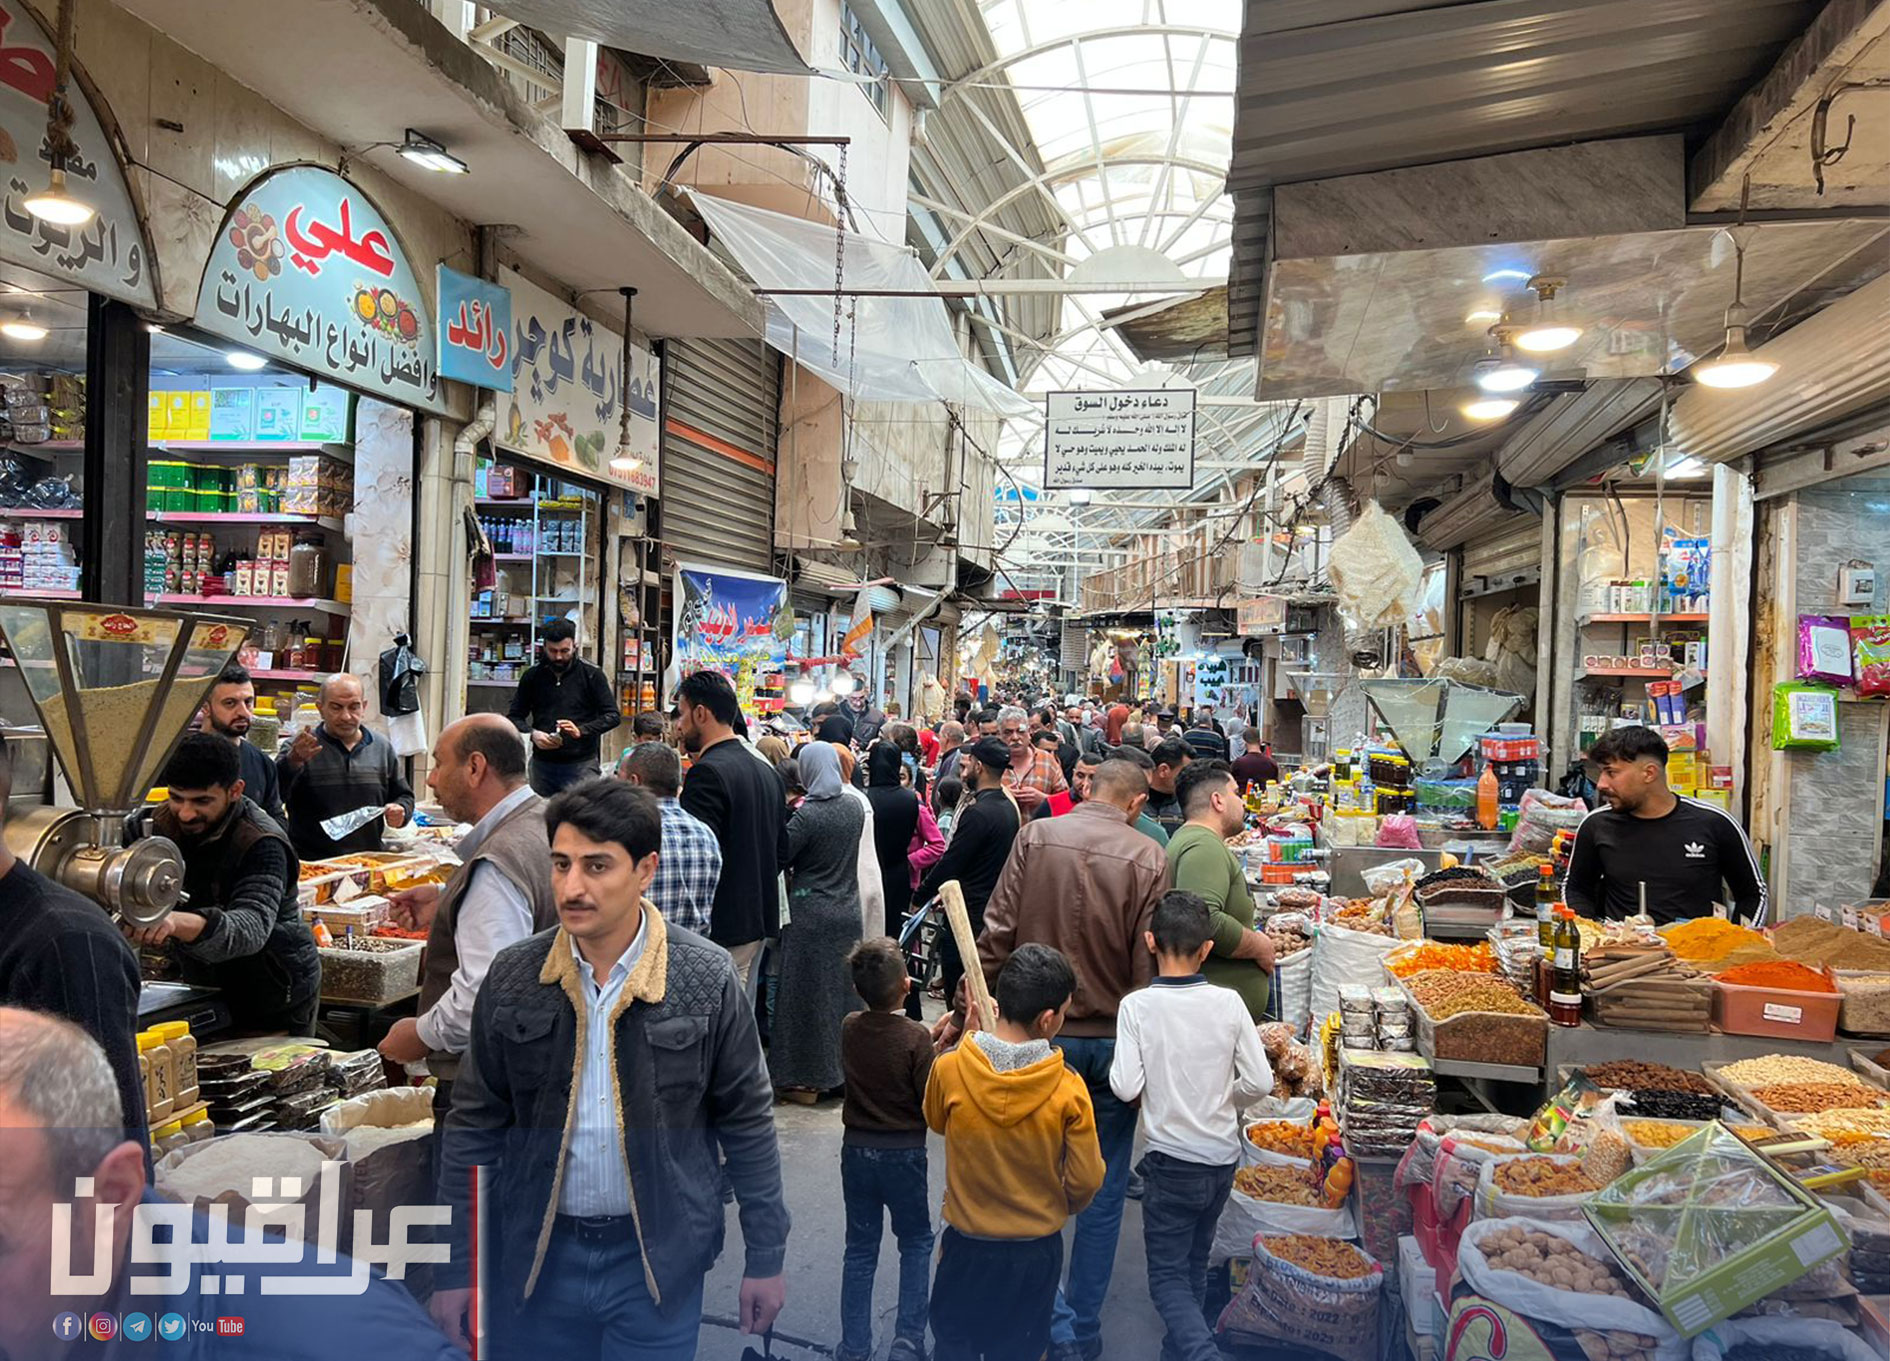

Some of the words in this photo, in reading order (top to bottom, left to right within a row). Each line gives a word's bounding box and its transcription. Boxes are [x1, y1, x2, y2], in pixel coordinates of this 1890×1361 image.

[285, 197, 395, 278] علي
[216, 270, 321, 354] البهارات
[448, 300, 508, 369] رائد
[325, 323, 377, 374] انواع
[380, 345, 439, 402] وافضل
[1074, 396, 1107, 412] السوق
[1109, 395, 1139, 411] دخول
[1141, 395, 1168, 409] دعاء
[1055, 426, 1070, 434] له
[1144, 424, 1154, 434] الله
[1181, 424, 1186, 434] لا
[1055, 444, 1061, 452] لا
[1126, 444, 1150, 453] الحمد
[1152, 444, 1162, 454] وله
[1178, 444, 1186, 453] له
[1055, 461, 1072, 475] قدير
